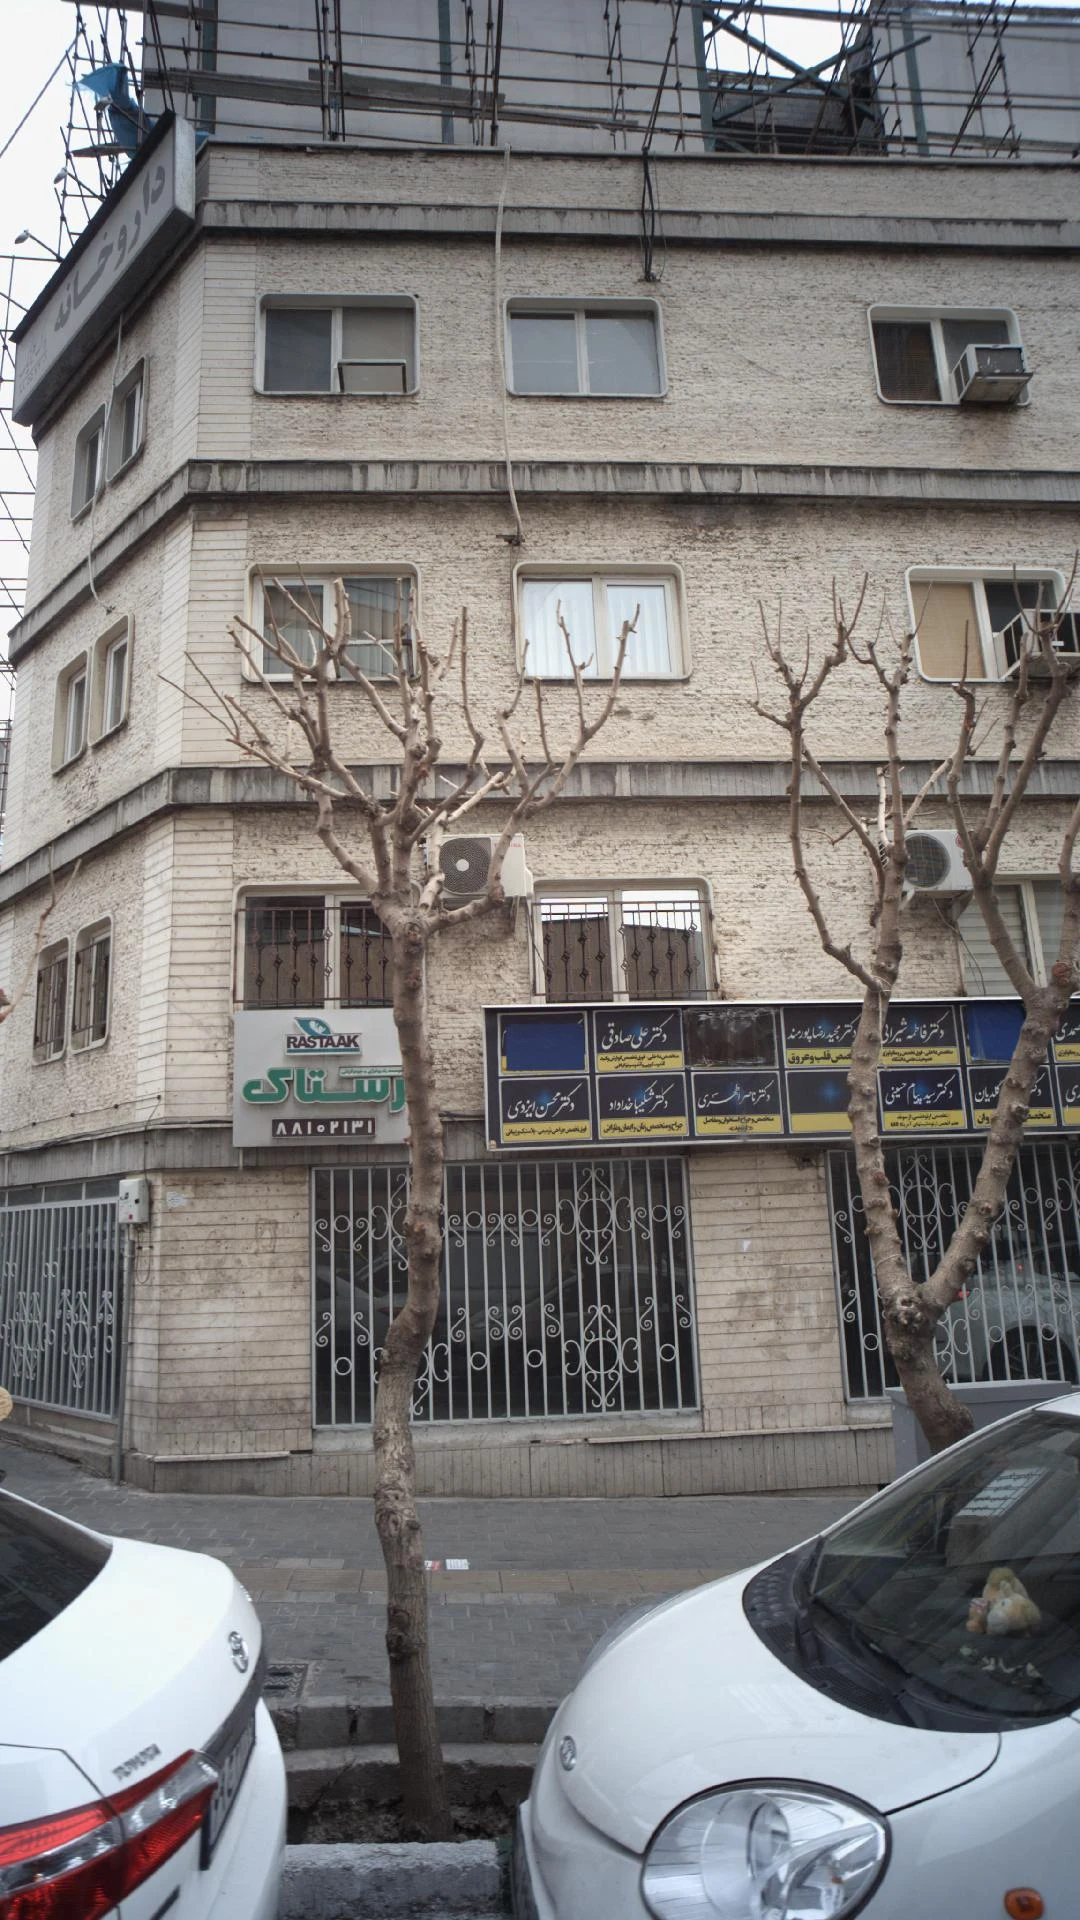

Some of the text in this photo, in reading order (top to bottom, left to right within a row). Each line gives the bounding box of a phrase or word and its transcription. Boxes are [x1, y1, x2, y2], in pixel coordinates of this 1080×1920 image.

[55, 164, 166, 333] داروخانه
[286, 1035, 360, 1049] RASTAAK
[601, 1013, 674, 1050] دکتر علی صادقی
[787, 1028, 811, 1043] پورمند
[835, 1012, 862, 1042] دکتر
[907, 1024, 928, 1040] فاطمه
[923, 1011, 950, 1043] دکتر
[788, 1053, 810, 1064] عروق
[814, 1050, 832, 1063] قلب
[242, 1067, 407, 1113] رستاک
[551, 1082, 583, 1117] دکتر
[608, 1080, 675, 1114] دکتر شکیبا خداداد
[755, 1080, 774, 1104] دکتر
[885, 1074, 955, 1105] دکتر سید پیام حسینی
[535, 1092, 562, 1118] محسن
